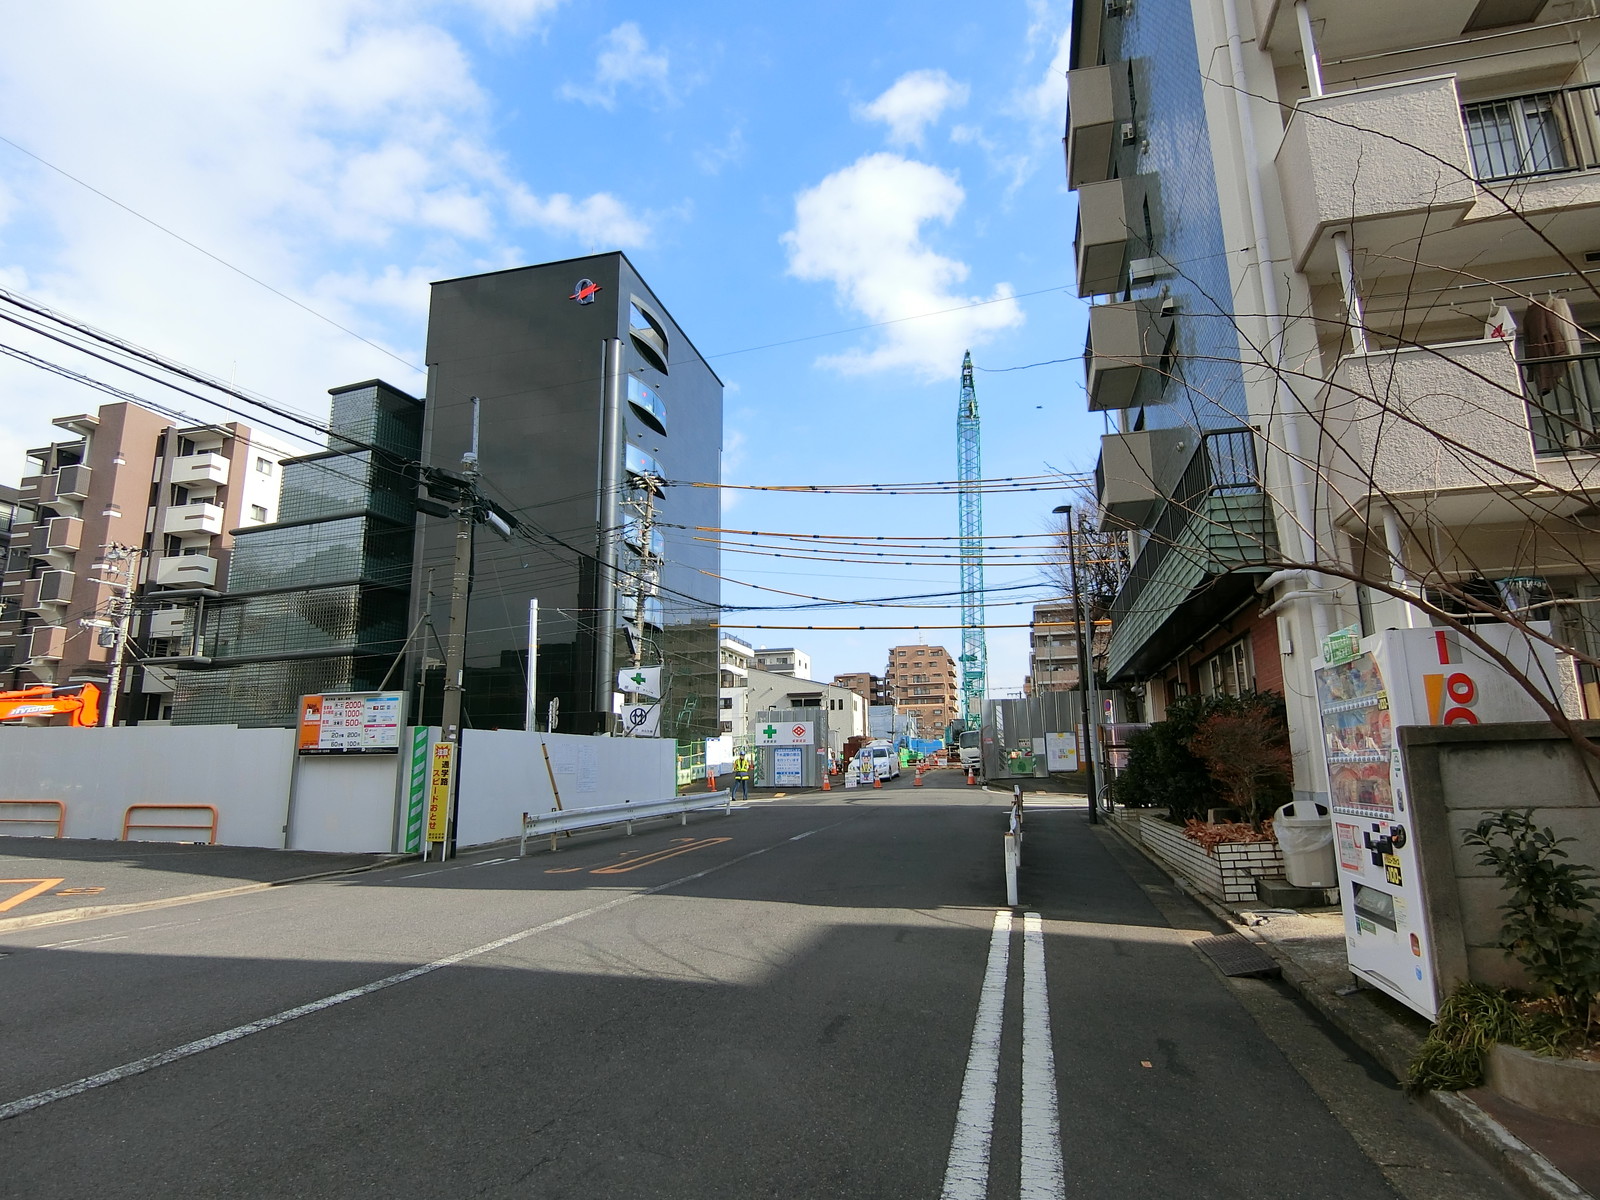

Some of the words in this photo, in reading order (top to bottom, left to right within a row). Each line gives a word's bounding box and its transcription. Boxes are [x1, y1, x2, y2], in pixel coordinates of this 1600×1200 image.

[441, 761, 449, 786] 通学路
[429, 770, 440, 830] スピードおとせ
